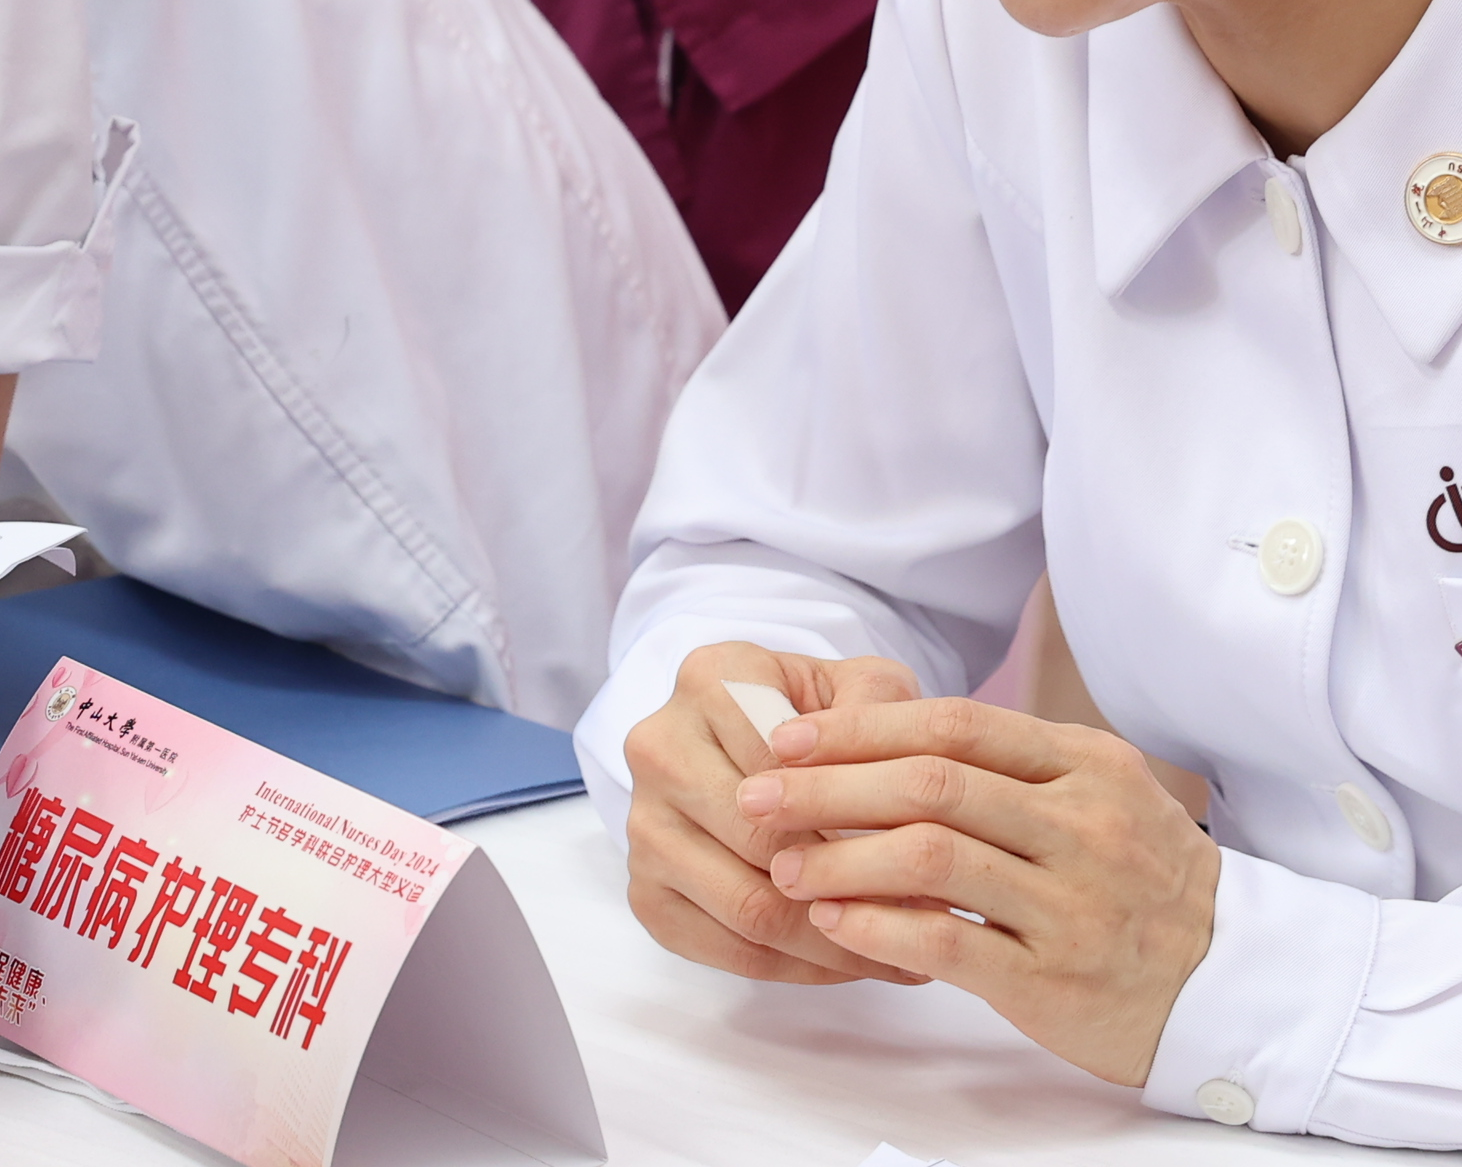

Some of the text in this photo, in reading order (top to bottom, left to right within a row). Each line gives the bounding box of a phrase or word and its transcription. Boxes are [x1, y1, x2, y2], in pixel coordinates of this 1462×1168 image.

[65, 721, 75, 732] The
[73, 725, 86, 737] First
[145, 759, 168, 777] University
[238, 804, 426, 903] 护士节多学科联合护理大型义诊
[254, 780, 441, 878] International Nurses Day 2024
